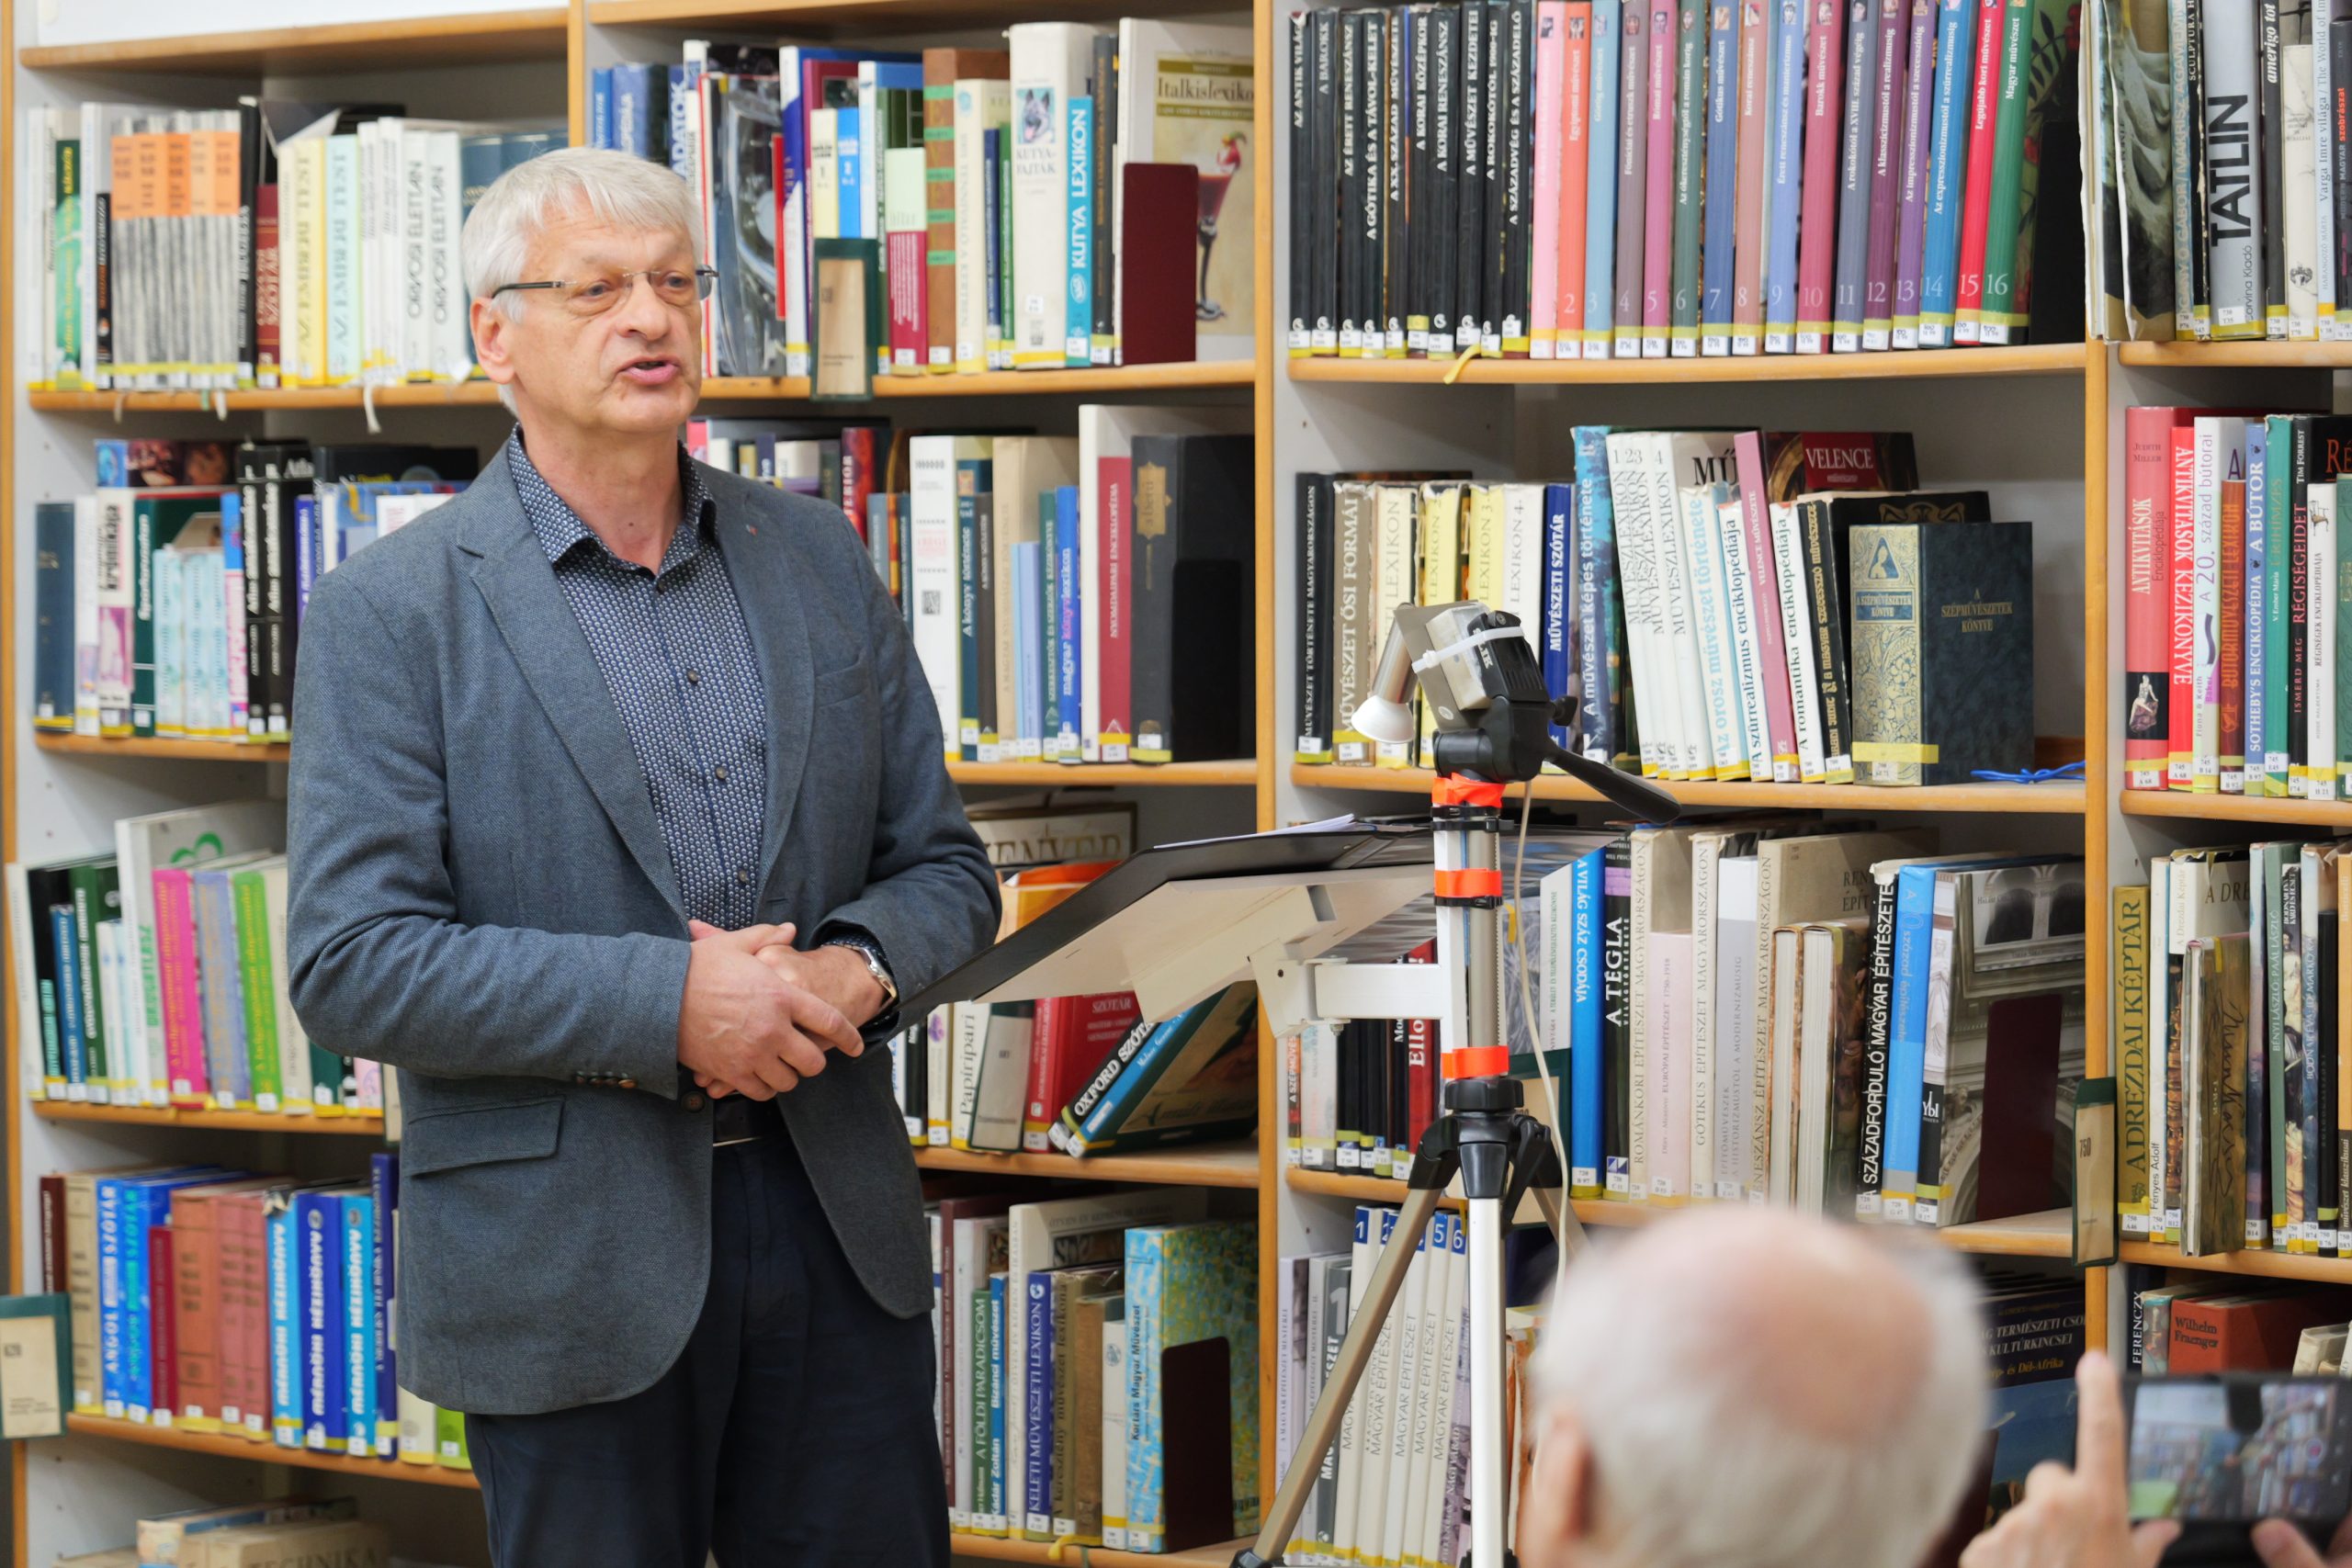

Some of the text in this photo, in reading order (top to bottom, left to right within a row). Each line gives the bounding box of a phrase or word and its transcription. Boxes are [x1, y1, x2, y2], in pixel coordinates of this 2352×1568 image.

[1318, 21, 1329, 95] A BAROKK
[1883, 28, 1895, 83] realizmusig
[2188, 13, 2196, 81] SCULPTURA
[2263, 4, 2279, 83] amerigo tot
[1464, 10, 1478, 175] A MŰVÉSZET KEZDETEI
[1511, 96, 1520, 107] A
[1815, 83, 1826, 116] Barokk
[1978, 65, 1988, 85] kori
[2006, 64, 2018, 99] Magyar
[672, 79, 686, 177] ADATOK
[1364, 21, 1377, 240] A GÓTIKA ÉS A TÁVOL-KELET
[1510, 109, 1520, 125] ÉS
[1905, 189, 1915, 202] Az
[1913, 27, 1925, 83] szecesszióig
[1974, 87, 1986, 130] Legújabb
[2315, 16, 2331, 201] Varga Imre világa The World of
[2336, 88, 2346, 141] szobrászat
[1071, 108, 1087, 268] KUTYA LEXIKON
[1509, 130, 1519, 211] SZÁZADVÉG
[2208, 94, 2251, 246] TATLIN
[1509, 215, 1518, 225] A
[1960, 274, 1979, 297] 15
[1986, 273, 2007, 295] 16
[2243, 245, 2252, 277] Kiadó
[1564, 297, 1575, 313] 2
[1647, 290, 1657, 312] 5
[1709, 288, 1721, 309] 7
[1737, 287, 1747, 308] 8
[1771, 285, 1782, 305] 9
[1804, 287, 1823, 308] 10
[1868, 282, 1886, 302] 12
[1896, 280, 1915, 301] 13
[1805, 446, 1874, 469] VELENCE
[2295, 429, 2305, 484] TIM FORREST
[1306, 485, 1315, 598] MAGYARORSZÁGON
[1341, 498, 1358, 580] FORMÁI
[1579, 478, 1594, 558] története
[1687, 499, 1713, 584] története
[2129, 497, 2152, 594] ANTIKVITÁSOK
[2195, 434, 2215, 603] A 20. század bútorai
[1107, 483, 1119, 638] NYOMDAIPARI ENCIKLOPÉDIA
[1385, 502, 1399, 598] LEXIKON
[1755, 544, 1768, 585] VELENCE
[2151, 511, 2166, 581] Enciklopédiája
[1549, 513, 1565, 650] MŰVÉSZETI SZÓTÁR
[1580, 561, 1597, 614] képes
[1724, 519, 1747, 634] enciklopédiája
[2271, 571, 2279, 591] Mária
[2272, 592, 2280, 614] Ember
[1060, 547, 1074, 695] magyar könyvlexikon
[1776, 518, 1809, 750] A romantika enciklopédiája
[2245, 461, 2264, 752] SOTHEBY'S ENCIKLOPÉDIA A BÚTOR
[2290, 502, 2307, 713] ISMERD MEG RÉGISÉGEIDET
[2312, 552, 2324, 667] RÉGISÉGEK ENCIKLOPÉDIÁJA
[1306, 603, 1314, 671] TÖRTÉNETE
[1584, 703, 1595, 716] A
[1710, 678, 1726, 728] orosz
[2195, 675, 2204, 701] Keith
[2204, 675, 2213, 702] Baker
[2195, 712, 2204, 738] Fiona
[1748, 751, 1763, 762] A
[1577, 859, 1589, 1003] A VILÁG SZÁZ CSODÁJA
[2267, 909, 2280, 949] LÁSZLÓ
[1604, 917, 1623, 1026] A TÉGLA
[2269, 952, 2280, 976] PAÁL
[1695, 848, 1709, 1145] GÓTIKUS ÉPÍTÉSZET MAGYARORSZÁGON
[1862, 883, 1894, 1183] SZÁZADFORDULÓ MAGYAR ÉPÍTÉSZETE
[2119, 901, 2145, 1174] A DREZDAI KÉPTÁR
[2270, 1025, 2280, 1052] BÉNYI
[959, 1014, 977, 1116] Papíripari
[1074, 1060, 1121, 1116] OXFORD
[2149, 1141, 2161, 1168] Adolf
[1434, 1224, 1445, 1241] 5
[104, 1313, 119, 1373] ANGOL
[1029, 1303, 1042, 1367] LEXIKON
[1989, 1332, 2073, 1356] KULTÚRKINCSEI
[1996, 1317, 2061, 1337] TERMÉSZETI
[2132, 1292, 2143, 1364] FERENCZY
[2174, 1331, 2220, 1349] Fraenger
[2175, 1315, 2218, 1334] Wilhelm
[974, 1299, 986, 1460] A FÖLDI PARADICSOM
[1130, 1304, 1142, 1440] Kortárs Magyar Művészet
[1394, 1393, 1409, 1457] MAGYAR
[1028, 1461, 1041, 1511] KELETI
